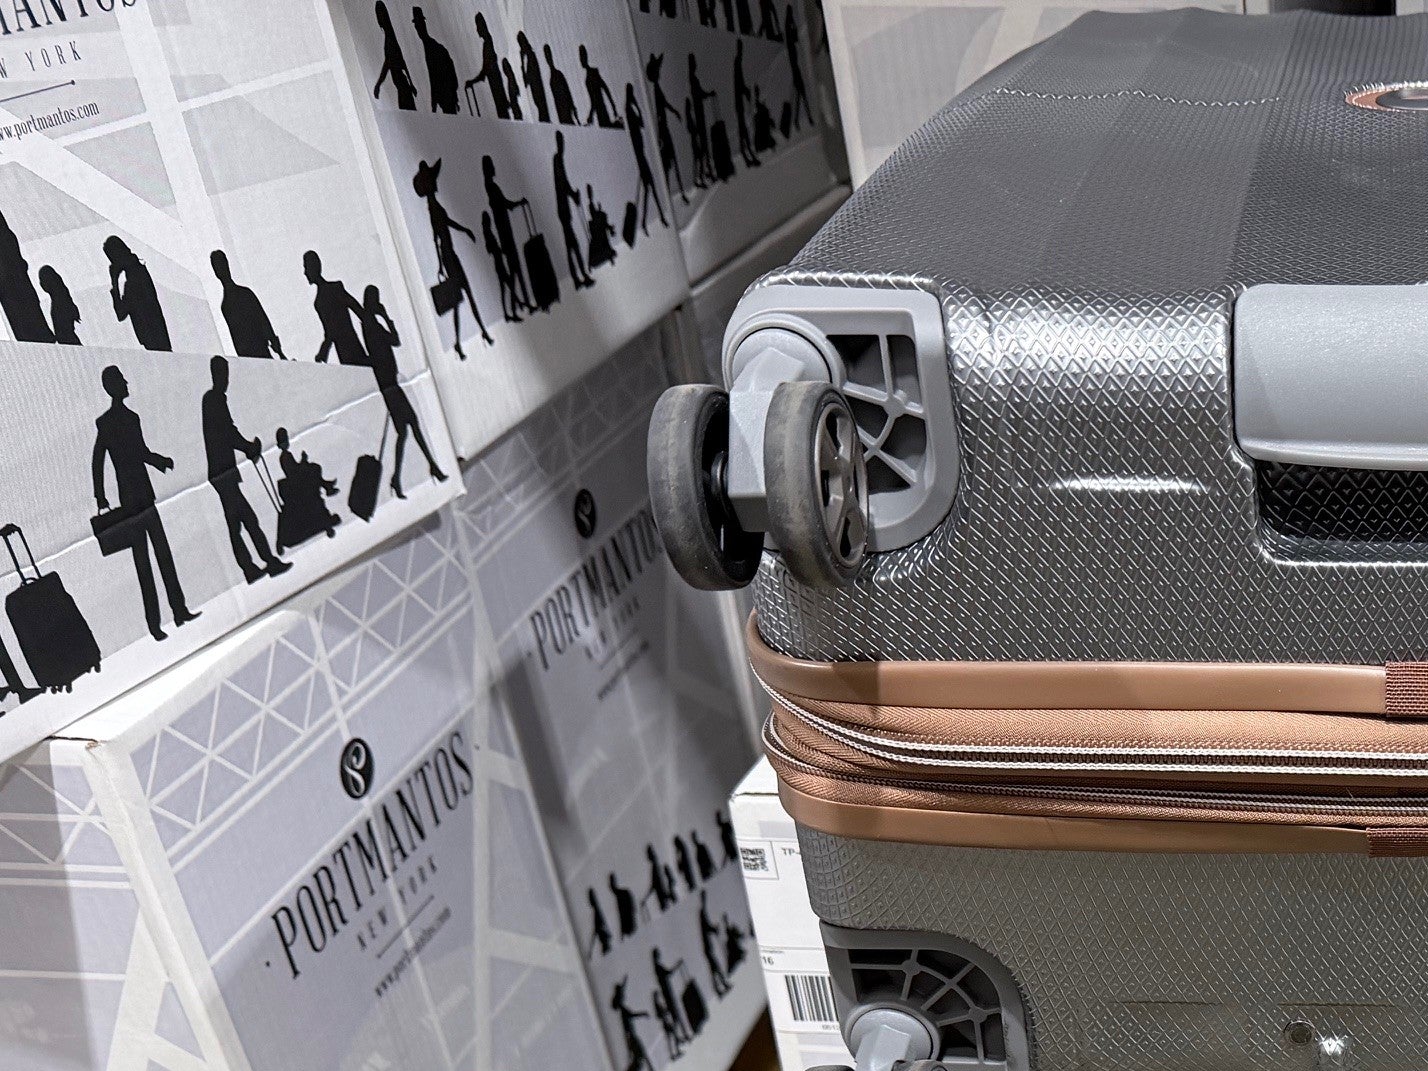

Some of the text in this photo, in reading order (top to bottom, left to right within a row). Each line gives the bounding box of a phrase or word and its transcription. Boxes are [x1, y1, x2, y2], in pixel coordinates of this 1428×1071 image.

[24, 40, 82, 72] YORK
[0, 102, 100, 141] w.portmantos.com
[271, 731, 474, 980] PORTMANTOS
